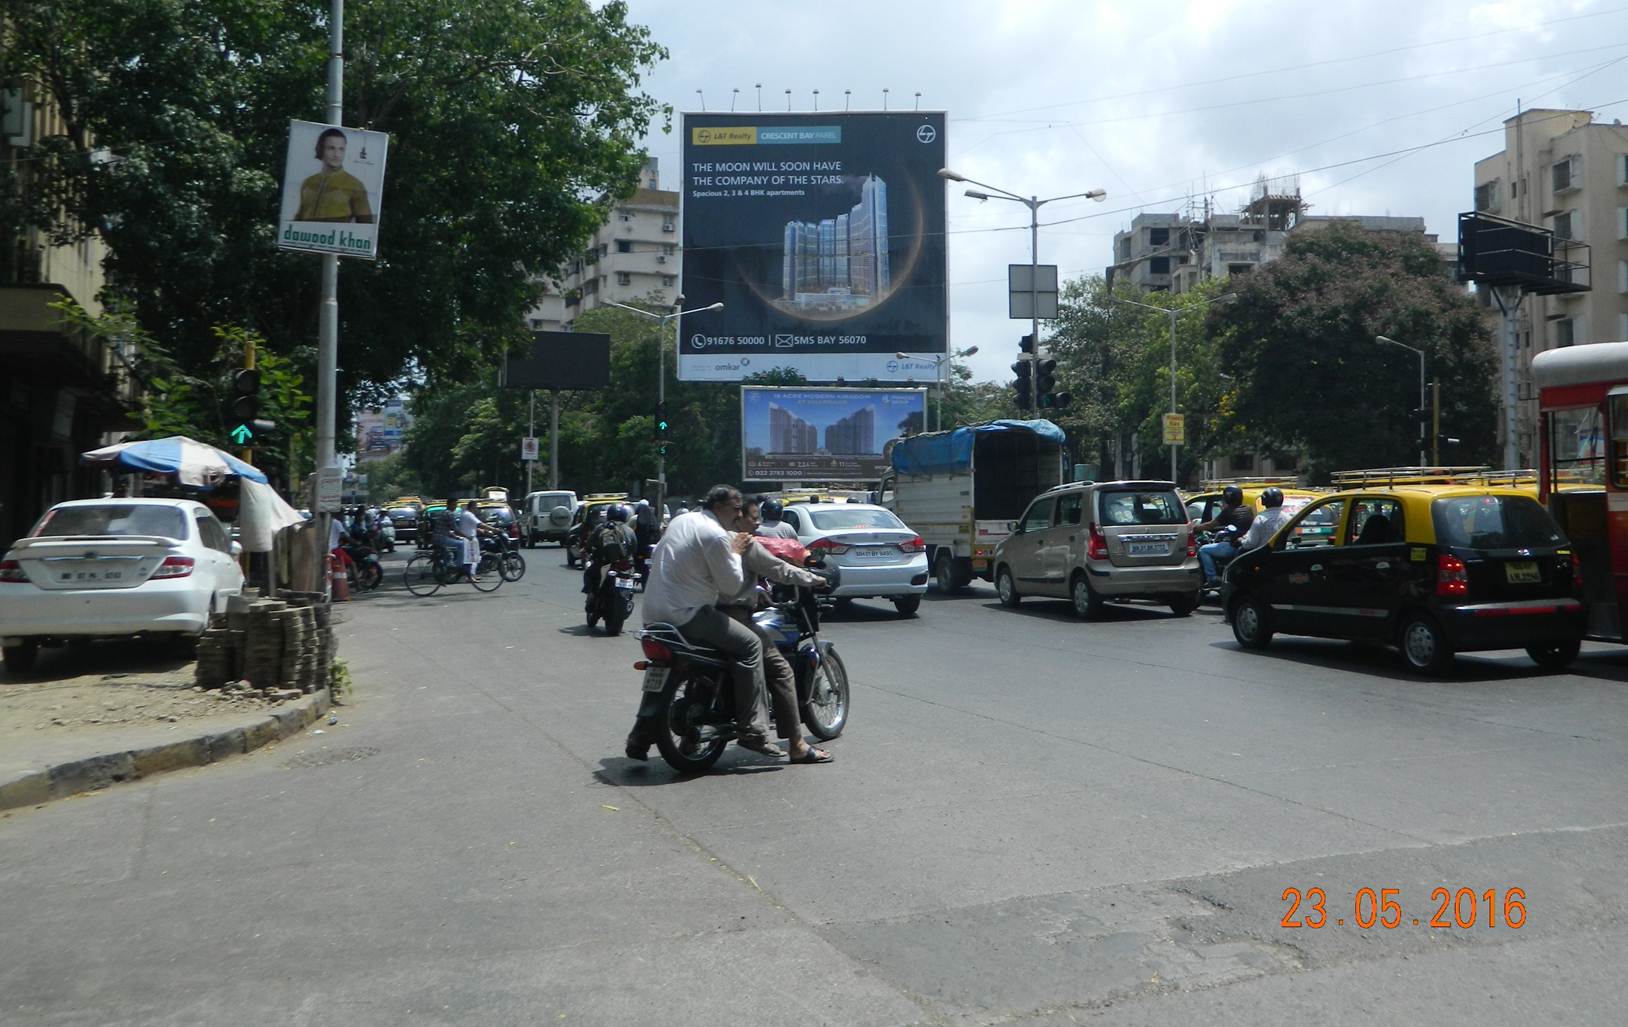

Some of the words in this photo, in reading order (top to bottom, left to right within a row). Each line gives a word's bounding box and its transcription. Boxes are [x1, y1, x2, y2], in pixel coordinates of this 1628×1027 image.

[692, 163, 713, 172] THE
[715, 162, 750, 172] MOON
[752, 162, 778, 172] WILL
[780, 161, 810, 171] SOON
[813, 161, 842, 170] HAVE
[692, 176, 712, 186] THE
[715, 176, 769, 186] COMPANY
[771, 176, 786, 184] OF
[788, 175, 808, 184] THE
[810, 175, 844, 184] STARS.
[692, 190, 722, 198] Spacious
[766, 189, 805, 197] apartments
[283, 224, 336, 245] dawood
[340, 230, 371, 250] khan
[707, 336, 735, 345] 91676
[737, 336, 765, 345] 50000
[794, 336, 815, 345] SMS
[817, 336, 836, 345] BAY
[839, 335, 867, 344] 56070
